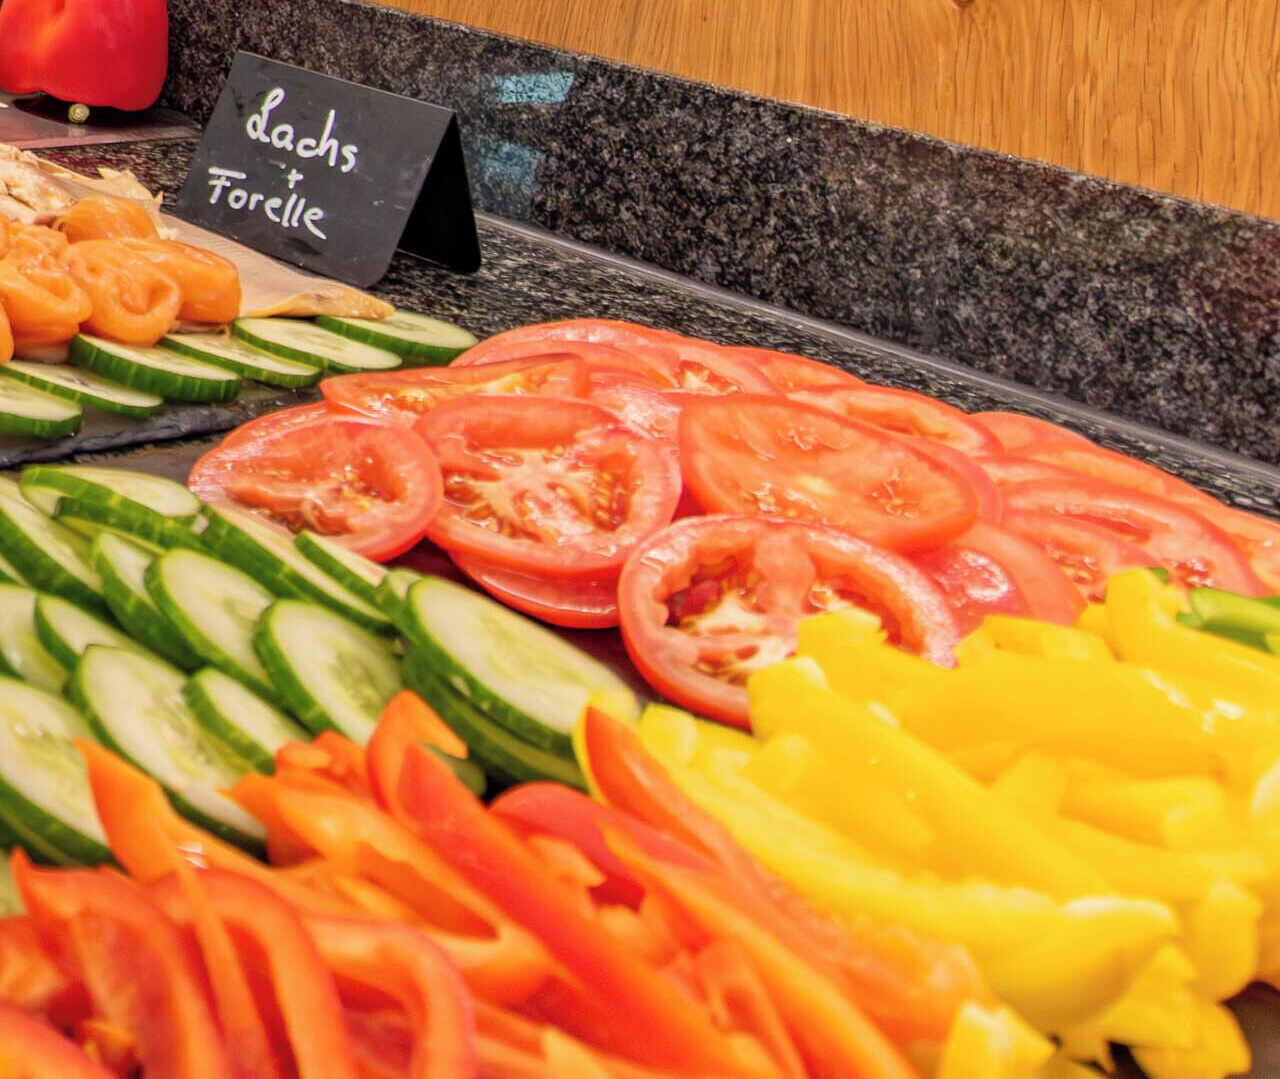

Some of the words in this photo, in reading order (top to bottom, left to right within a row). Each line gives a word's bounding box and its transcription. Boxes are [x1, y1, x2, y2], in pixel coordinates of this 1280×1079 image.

[246, 87, 358, 173] Lachs
[208, 166, 328, 240] Forelle
[288, 168, 304, 189] +
